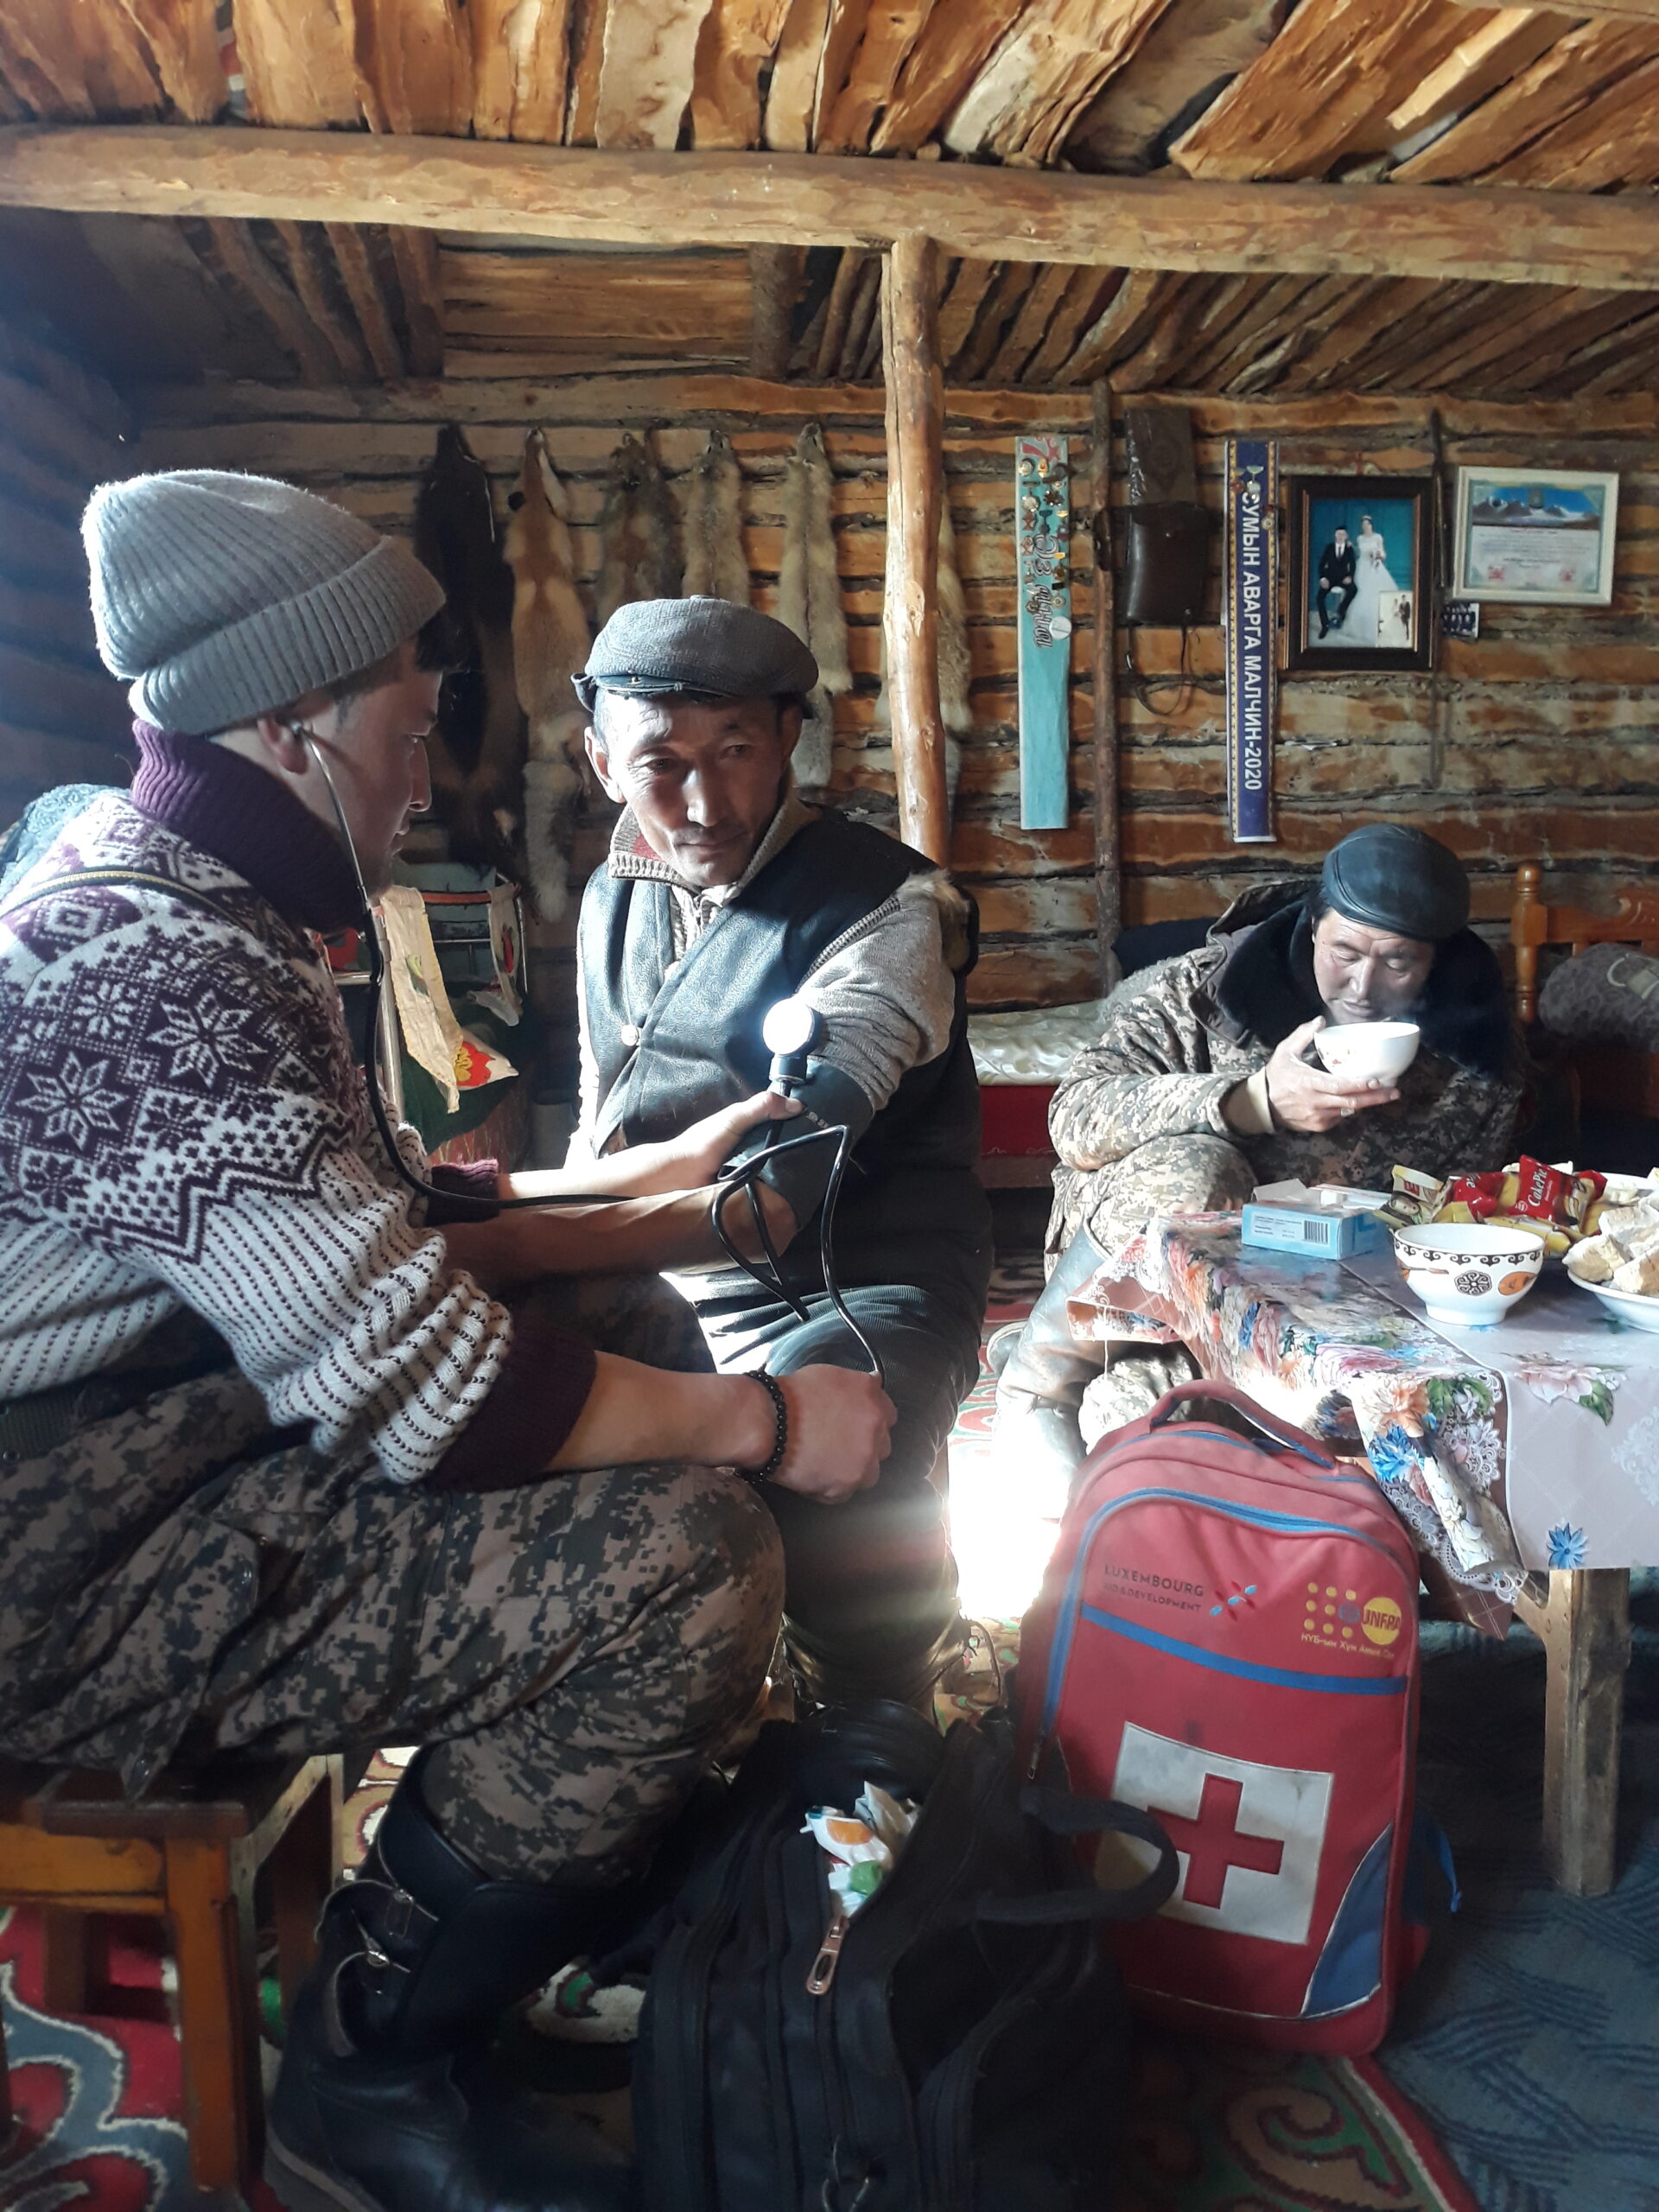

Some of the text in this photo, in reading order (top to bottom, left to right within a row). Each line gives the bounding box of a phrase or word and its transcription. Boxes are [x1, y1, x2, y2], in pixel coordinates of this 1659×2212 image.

[1242, 490, 1262, 791] СУМЫН АВАРГА МАЛЧИН-2020
[1104, 1563, 1205, 1598] LUXEMBOURG
